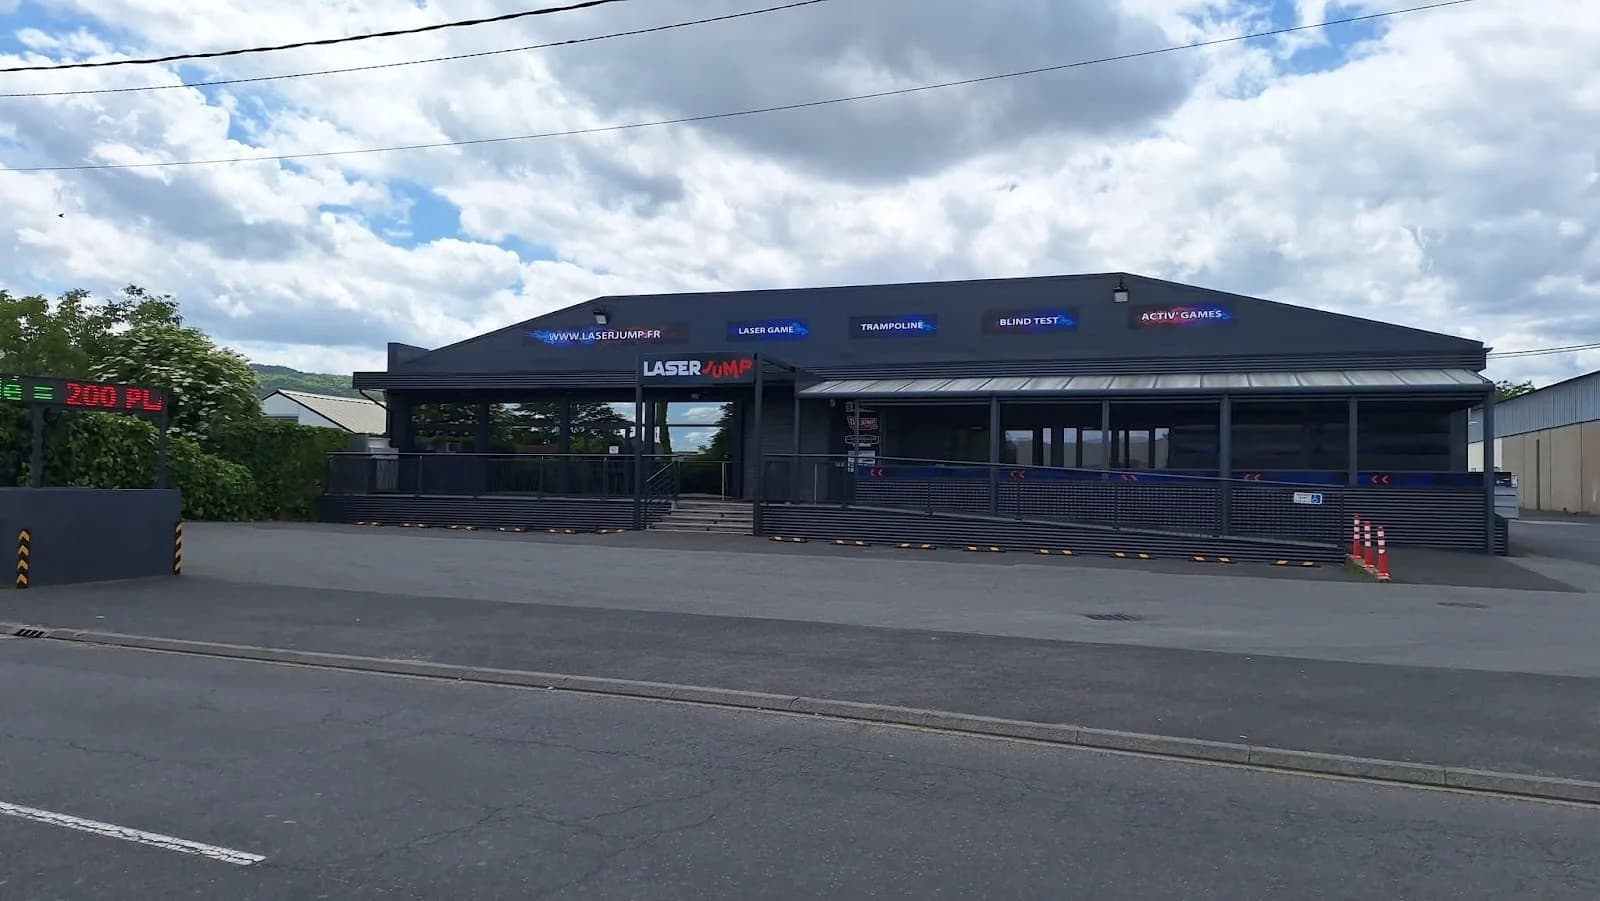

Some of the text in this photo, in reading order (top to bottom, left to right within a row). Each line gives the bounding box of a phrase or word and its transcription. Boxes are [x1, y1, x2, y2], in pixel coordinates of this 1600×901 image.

[1180, 310, 1222, 319] GAMES
[860, 321, 924, 331] TRAMPOLINE
[1000, 316, 1059, 326] BLIND TEST
[548, 330, 661, 341] WWW.LASERJUMP.FR
[738, 326, 794, 335] LASER GAME
[643, 359, 753, 379] LASER JUMP
[65, 383, 118, 408] 200
